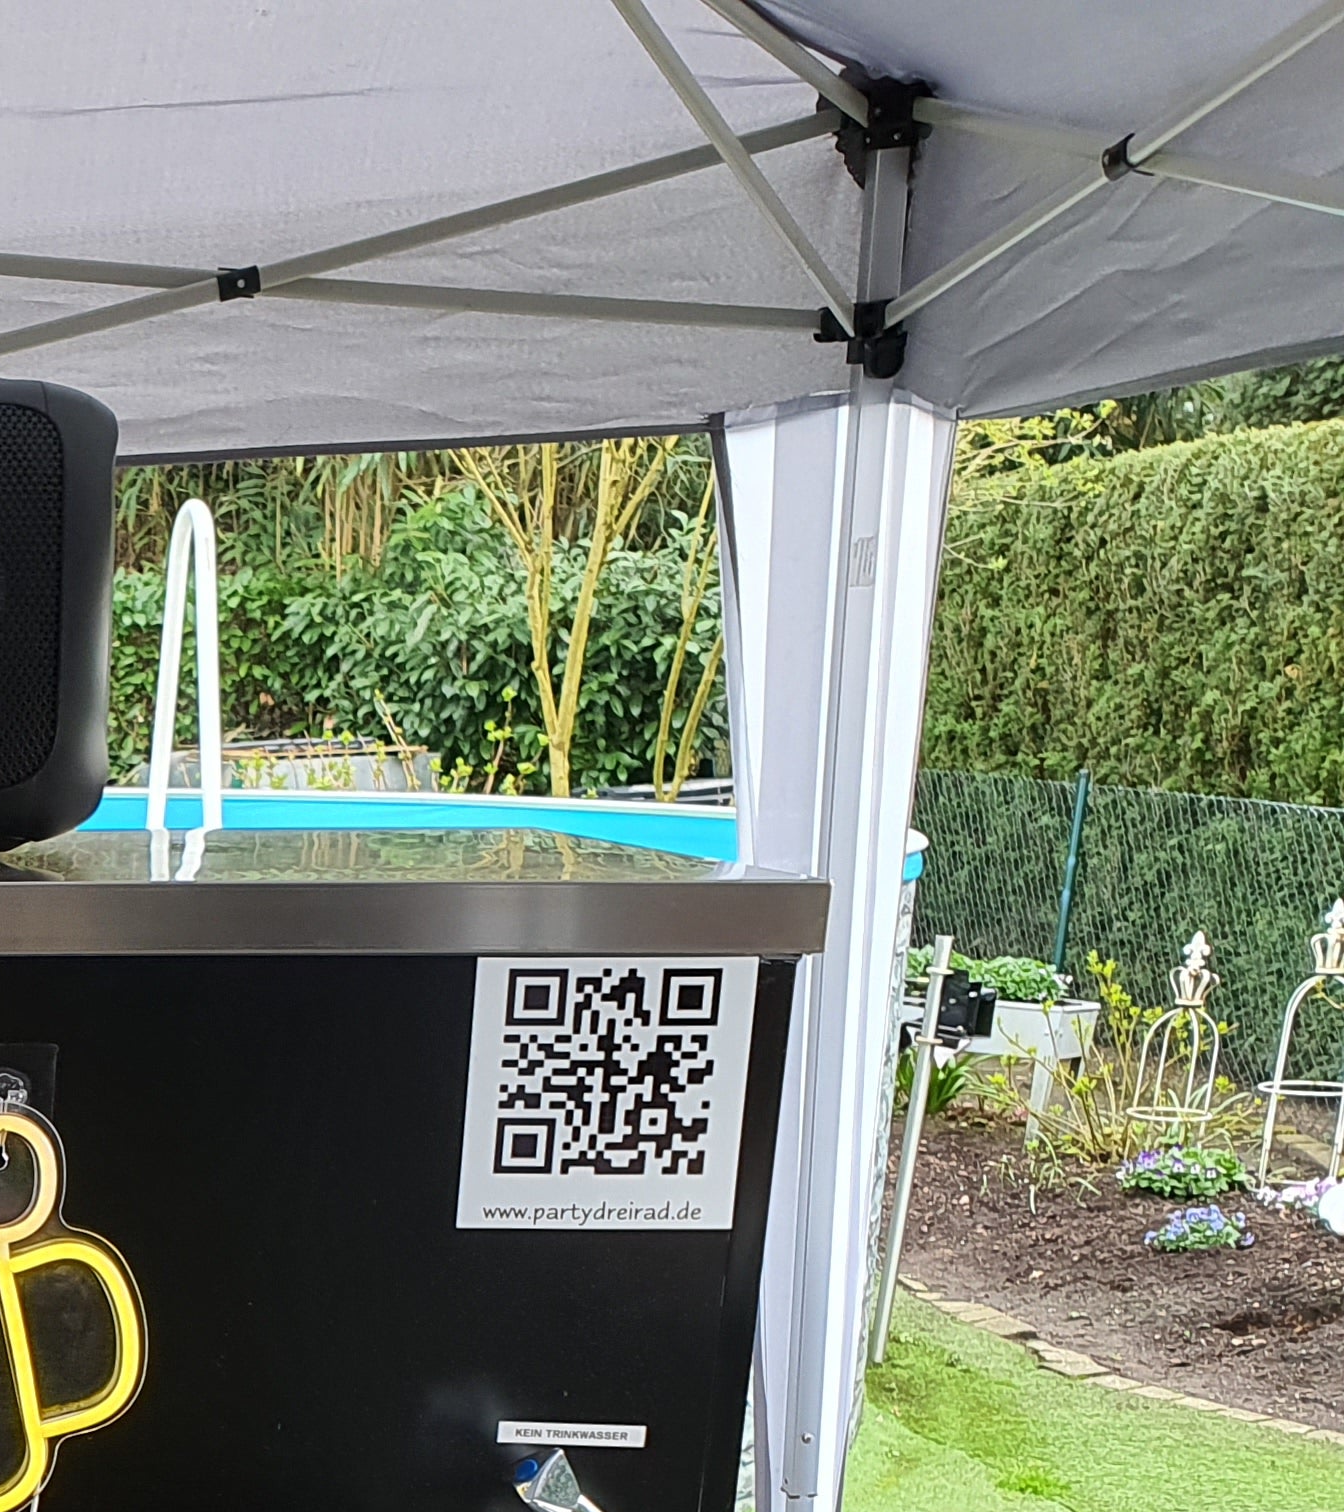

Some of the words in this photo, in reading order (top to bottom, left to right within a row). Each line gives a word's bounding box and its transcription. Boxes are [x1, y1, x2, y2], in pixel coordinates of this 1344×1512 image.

[482, 1201, 702, 1225] www.partydreirad.de
[515, 1428, 543, 1438] KEIN
[546, 1429, 629, 1441] TRINKWASSER
